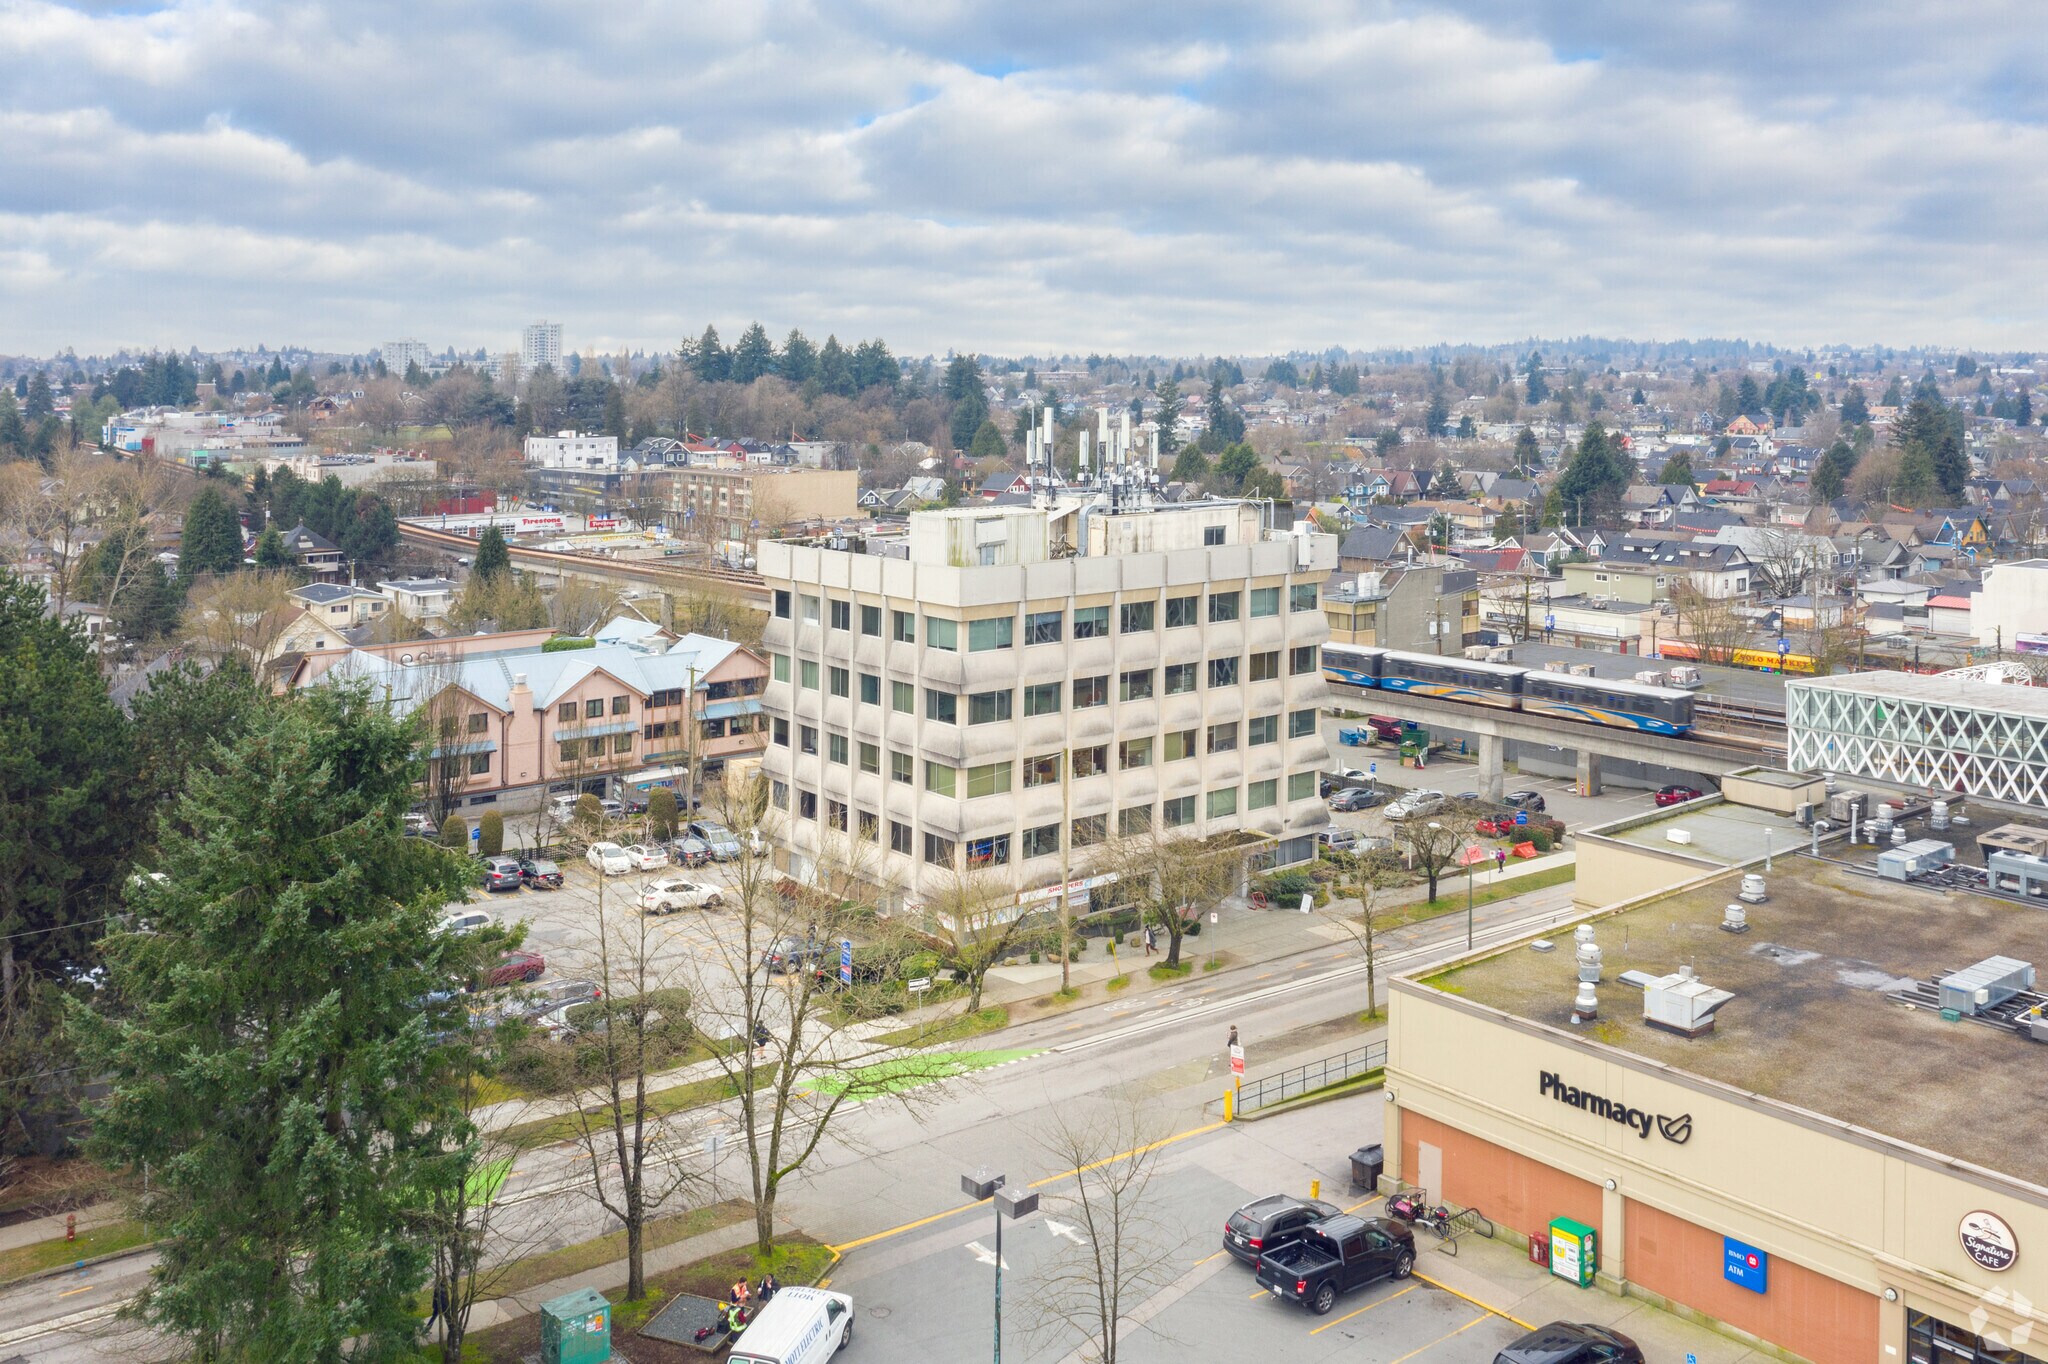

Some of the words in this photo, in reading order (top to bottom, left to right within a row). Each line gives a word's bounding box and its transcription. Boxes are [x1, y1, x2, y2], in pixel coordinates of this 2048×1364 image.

[1048, 881, 1083, 893] SHOPERS
[1540, 1070, 1653, 1139] Pharmacy
[1728, 1249, 1745, 1260] BMO
[1965, 1236, 2010, 1260] Signature
[1974, 1252, 1999, 1267] CAFE
[1728, 1265, 1744, 1277] ATM
[800, 1316, 823, 1352] ELECTRIC
